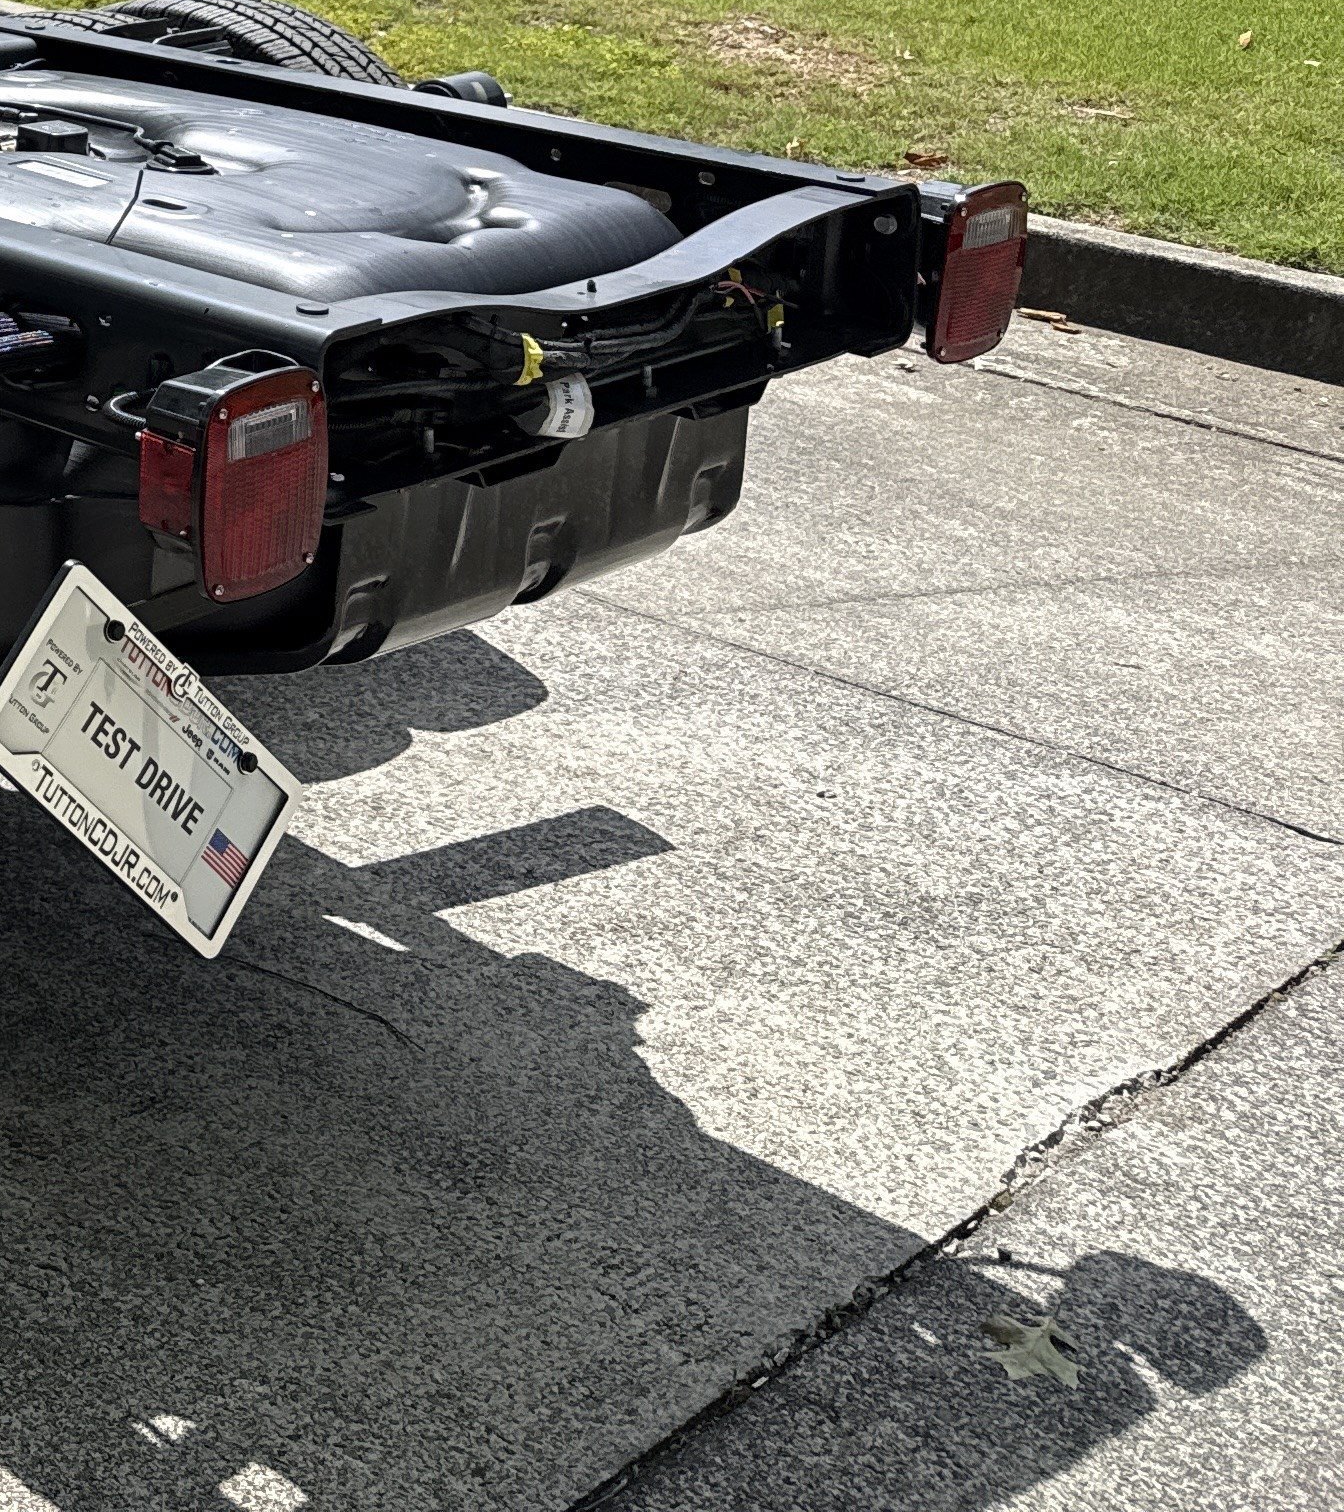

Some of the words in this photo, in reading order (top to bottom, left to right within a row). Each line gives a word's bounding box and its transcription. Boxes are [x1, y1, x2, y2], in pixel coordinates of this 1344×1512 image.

[556, 381, 575, 405] Park
[127, 621, 167, 664] POWERED
[165, 659, 179, 675] BY
[193, 685, 224, 723] TUTTON
[222, 716, 250, 747] GROUP
[8, 692, 30, 718] UTTON
[181, 723, 203, 751] Jeep
[80, 700, 142, 770] TEST
[134, 756, 205, 836] DRIVE
